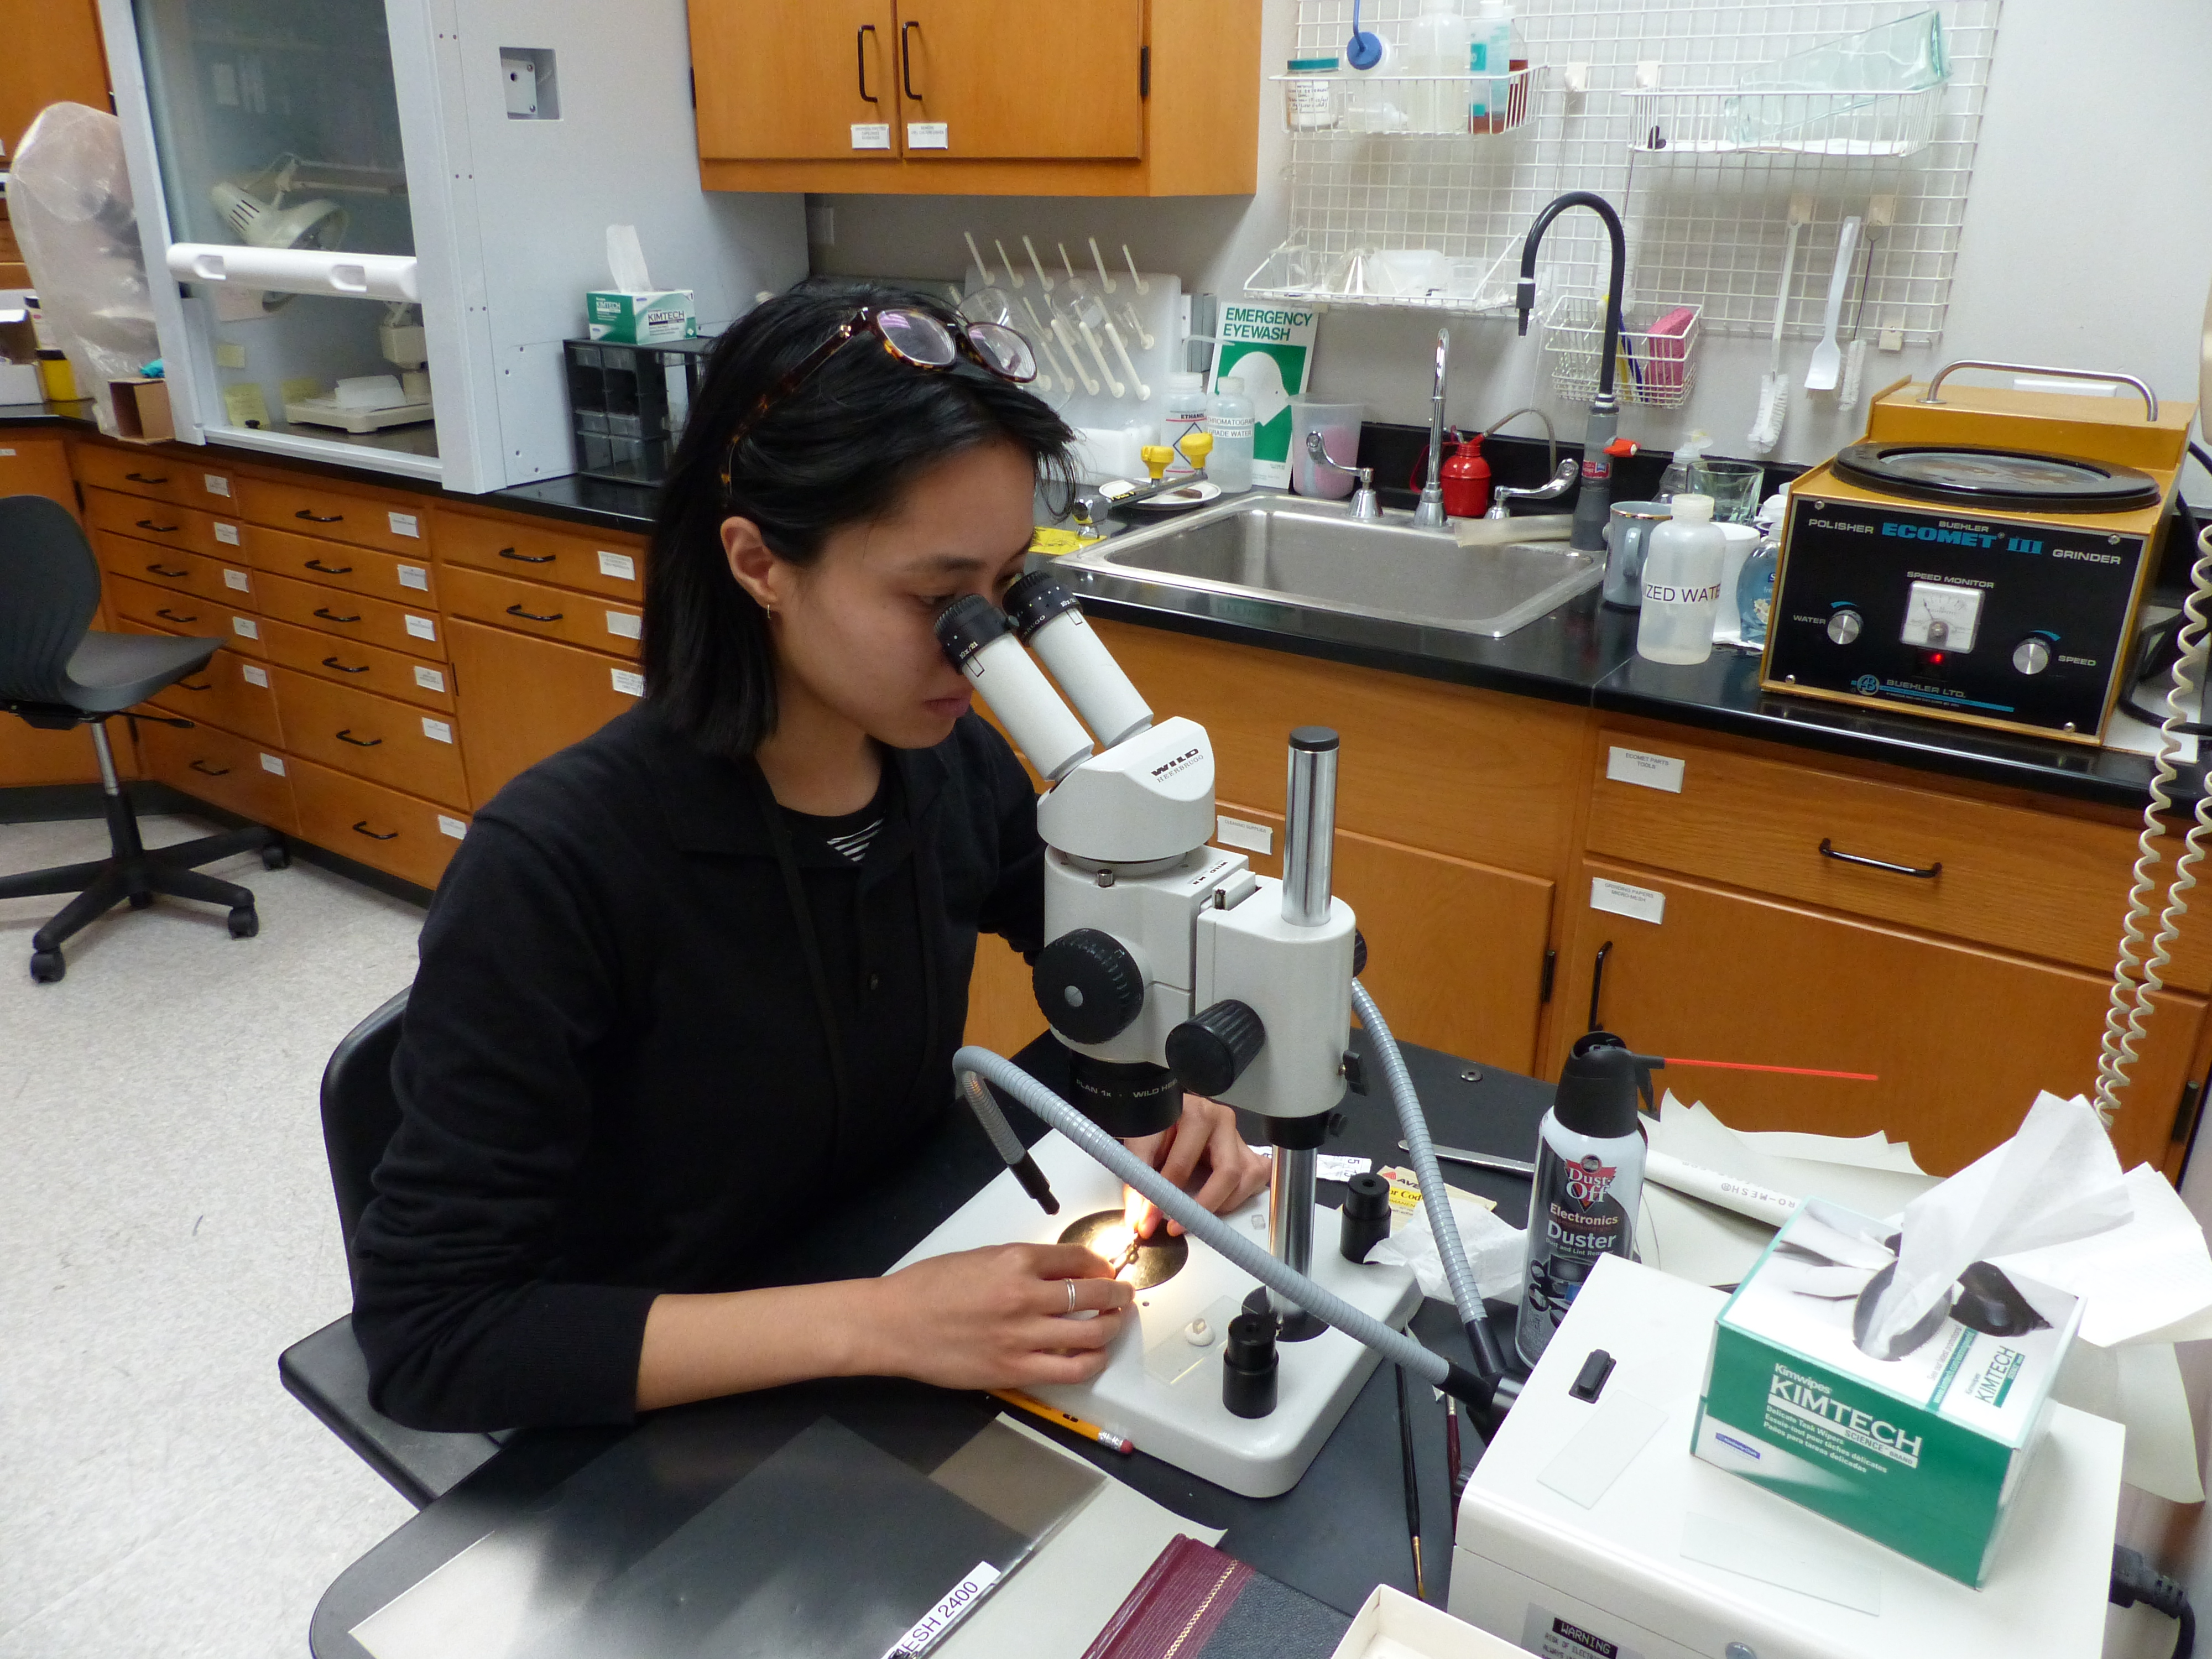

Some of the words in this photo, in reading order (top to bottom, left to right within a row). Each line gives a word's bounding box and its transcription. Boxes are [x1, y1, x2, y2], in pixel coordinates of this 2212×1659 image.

[648, 310, 685, 321] KIMTECH
[1225, 307, 1313, 327] EMERGENCY
[1223, 323, 1291, 341] EYEWASH
[1808, 518, 1874, 534] POLISHER
[1938, 520, 1989, 533] BUEHLER
[2052, 549, 2121, 565] GRINDER
[1907, 571, 1942, 582] SPEED
[1944, 576, 1995, 588] MONITOR
[1793, 614, 1827, 625] WATER
[2058, 655, 2097, 666] SPEED
[1886, 679, 1940, 693] BUEHLER
[1150, 748, 1199, 776] WILD
[1157, 754, 1204, 783] HEERBRUGG
[1625, 753, 1649, 762] ECOMET
[1650, 758, 1669, 766] PARTS
[1637, 761, 1656, 769] TOOLS
[1224, 819, 1245, 828] CLEANING
[1246, 824, 1266, 833] SUPPLIES
[1076, 1078, 1098, 1094] PLAN
[1133, 1087, 1160, 1098] WILD
[1566, 1181, 1610, 1203] Off
[1550, 1202, 1619, 1225] Electronics
[1546, 1237, 1558, 1248] Dust
[1547, 1219, 1616, 1249] Duster
[1775, 1363, 1832, 1395] Kimwipes
[1974, 1345, 2016, 1404] KIMTECH
[1767, 1404, 1797, 1423] Delicate
[1798, 1419, 1815, 1432] Task
[1817, 1427, 1844, 1445] Wipers
[1770, 1374, 1923, 1457] KIMTECH
[1806, 1433, 1824, 1445] pour
[1845, 1429, 1884, 1451] SCIENCE
[1889, 1451, 1913, 1465] BRAND
[1786, 1433, 1804, 1444] para
[1805, 1441, 1828, 1455] tareas
[1830, 1452, 1867, 1473] delicadas
[937, 1581, 978, 1618] 2400
[1545, 1632, 1559, 1645] RISK
[1562, 1640, 1569, 1648] OF
[1561, 1623, 1611, 1655] WARNING
[1542, 1644, 1564, 1658] ALWAYS
